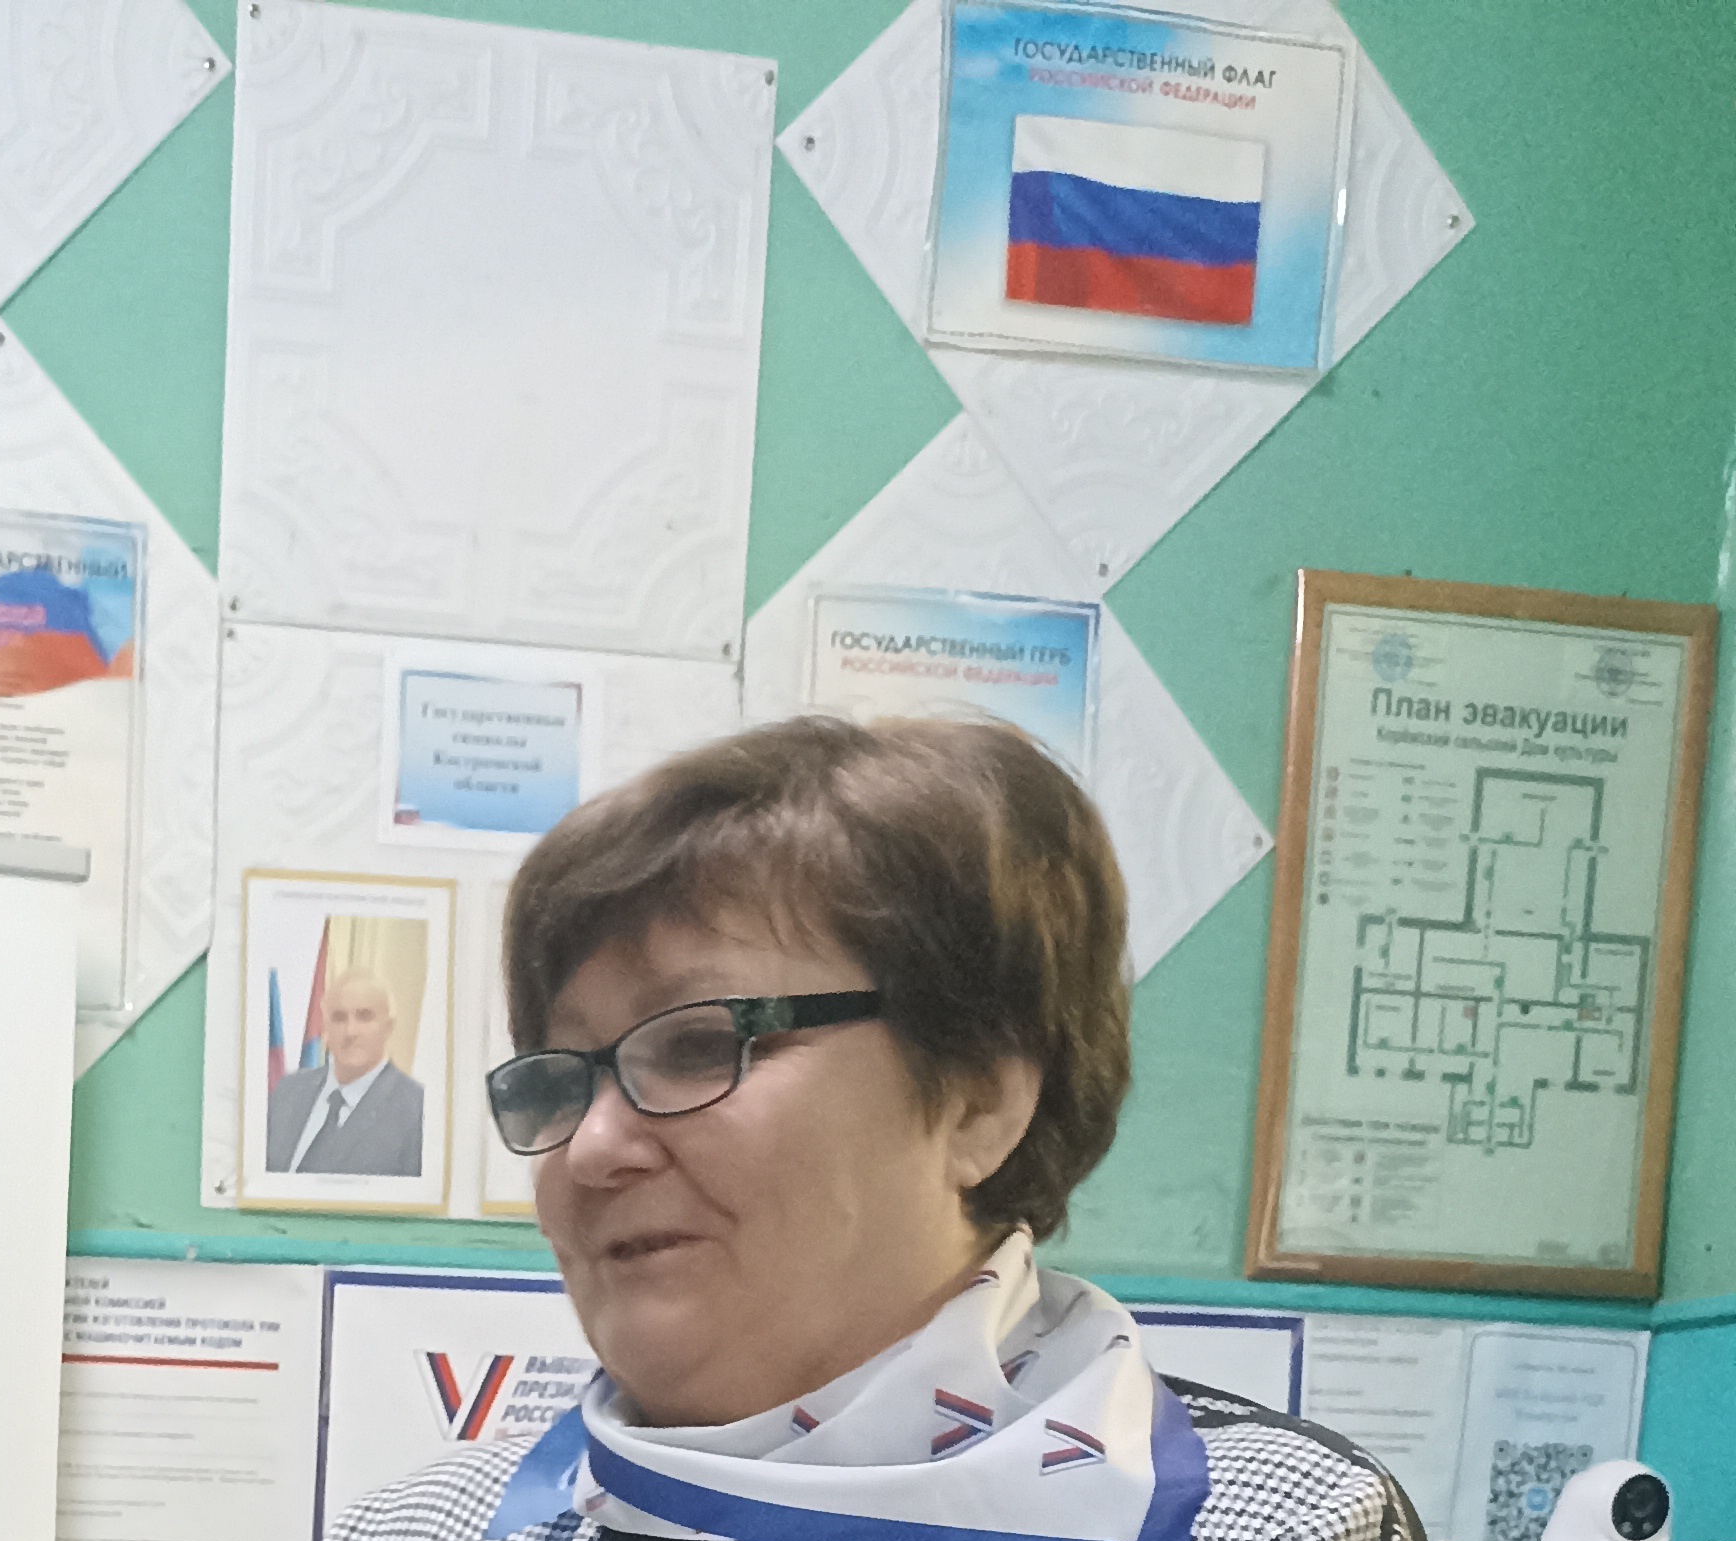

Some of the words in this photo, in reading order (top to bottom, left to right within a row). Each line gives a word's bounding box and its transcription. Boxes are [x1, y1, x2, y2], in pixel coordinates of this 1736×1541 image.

[1013, 37, 1216, 81] ГОСУДАРСТВЕННЫЙ
[1221, 64, 1278, 90] ФЛАГ
[1370, 687, 1451, 722] План
[1463, 702, 1628, 739] эвакуации
[500, 1403, 558, 1424] РОСС
